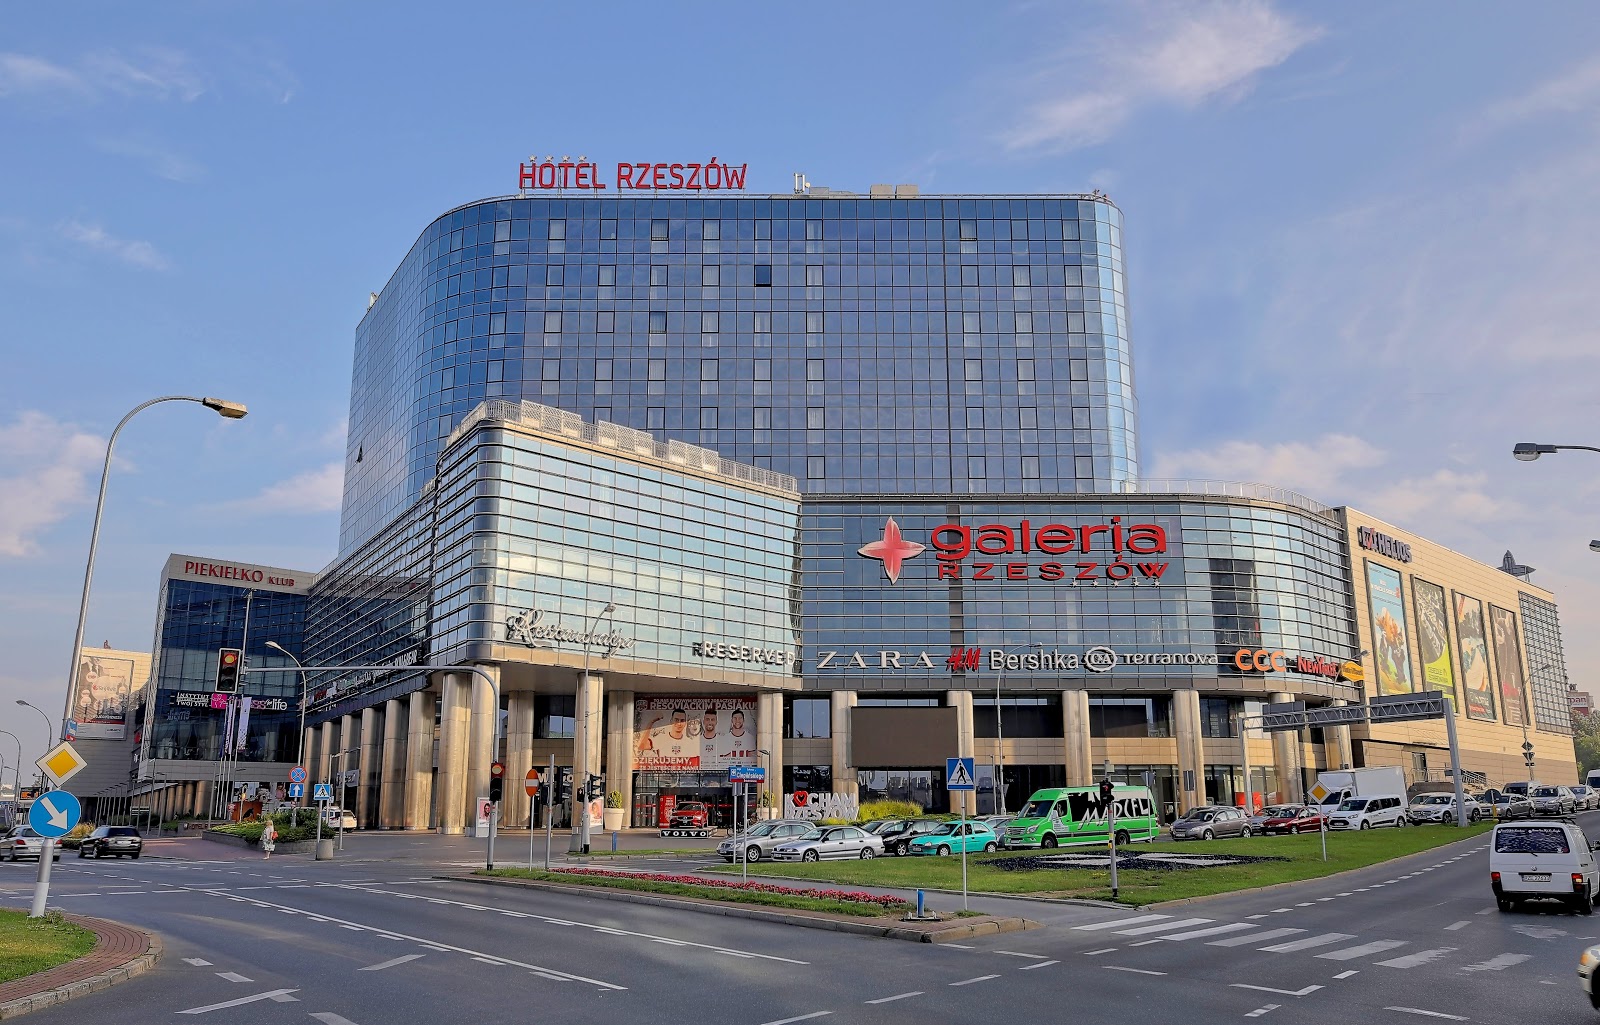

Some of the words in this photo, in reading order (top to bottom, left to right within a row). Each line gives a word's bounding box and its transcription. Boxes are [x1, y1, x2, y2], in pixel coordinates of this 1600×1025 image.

[519, 162, 606, 189] HOTEL
[617, 157, 747, 189] RZESZÓW
[931, 516, 1167, 559] galeria
[185, 561, 263, 582] PIEKIEŁKO
[268, 576, 295, 587] KLUB
[938, 555, 1169, 580] RZESZÓW
[703, 641, 796, 666] RESERVED
[816, 650, 936, 669] ZARA
[989, 649, 1080, 671] Bershka
[1090, 653, 1112, 665] C&A
[1235, 649, 1286, 672] CCC
[272, 698, 288, 710] life
